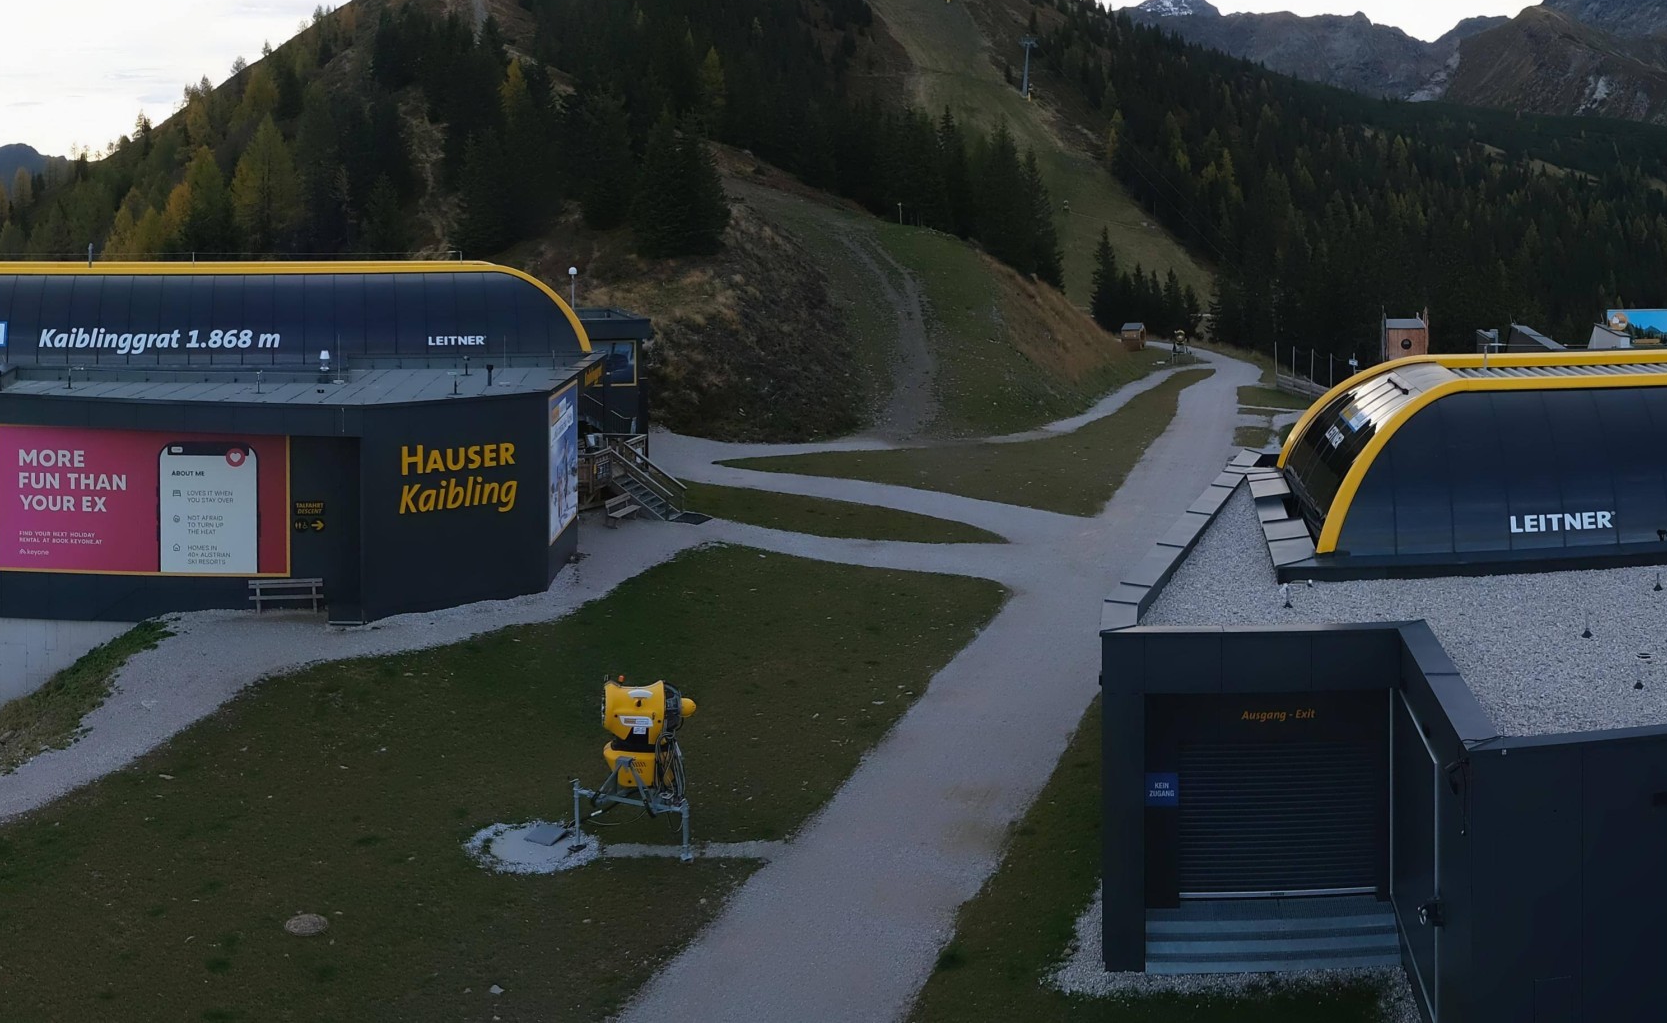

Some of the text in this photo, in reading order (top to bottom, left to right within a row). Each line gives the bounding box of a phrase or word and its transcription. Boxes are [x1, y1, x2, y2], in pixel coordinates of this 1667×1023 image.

[38, 328, 280, 354] Kaiblinggrat 1.868 m
[428, 336, 485, 346] LEITNER
[18, 449, 85, 468] MORE
[401, 442, 516, 476] HAUSER
[18, 472, 126, 490] FUN THAN
[20, 494, 107, 512] YOUR EX
[399, 476, 518, 514] Kaibling
[1510, 511, 1613, 533] LEITNER
[1242, 710, 1286, 722] Ausgang
[1295, 709, 1315, 719] Exit
